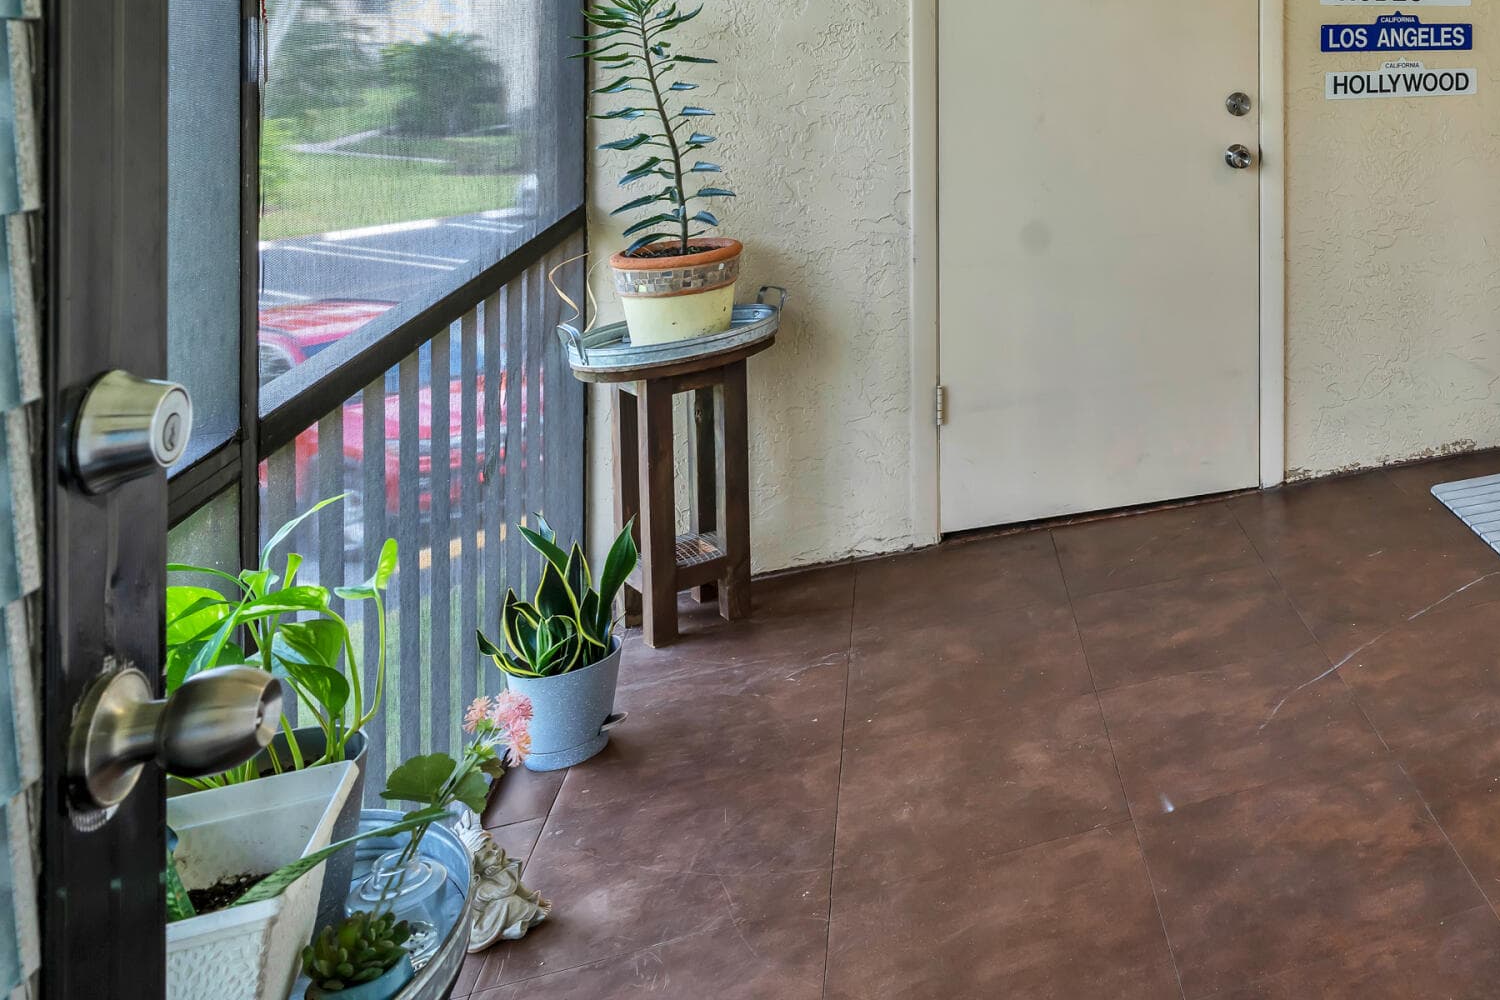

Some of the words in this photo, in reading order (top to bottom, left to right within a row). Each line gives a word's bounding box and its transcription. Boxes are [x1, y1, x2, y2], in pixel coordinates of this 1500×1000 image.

[1329, 28, 1367, 48] LOS
[1377, 27, 1464, 47] ANGELES
[1333, 72, 1469, 94] HOLLYWOOD
